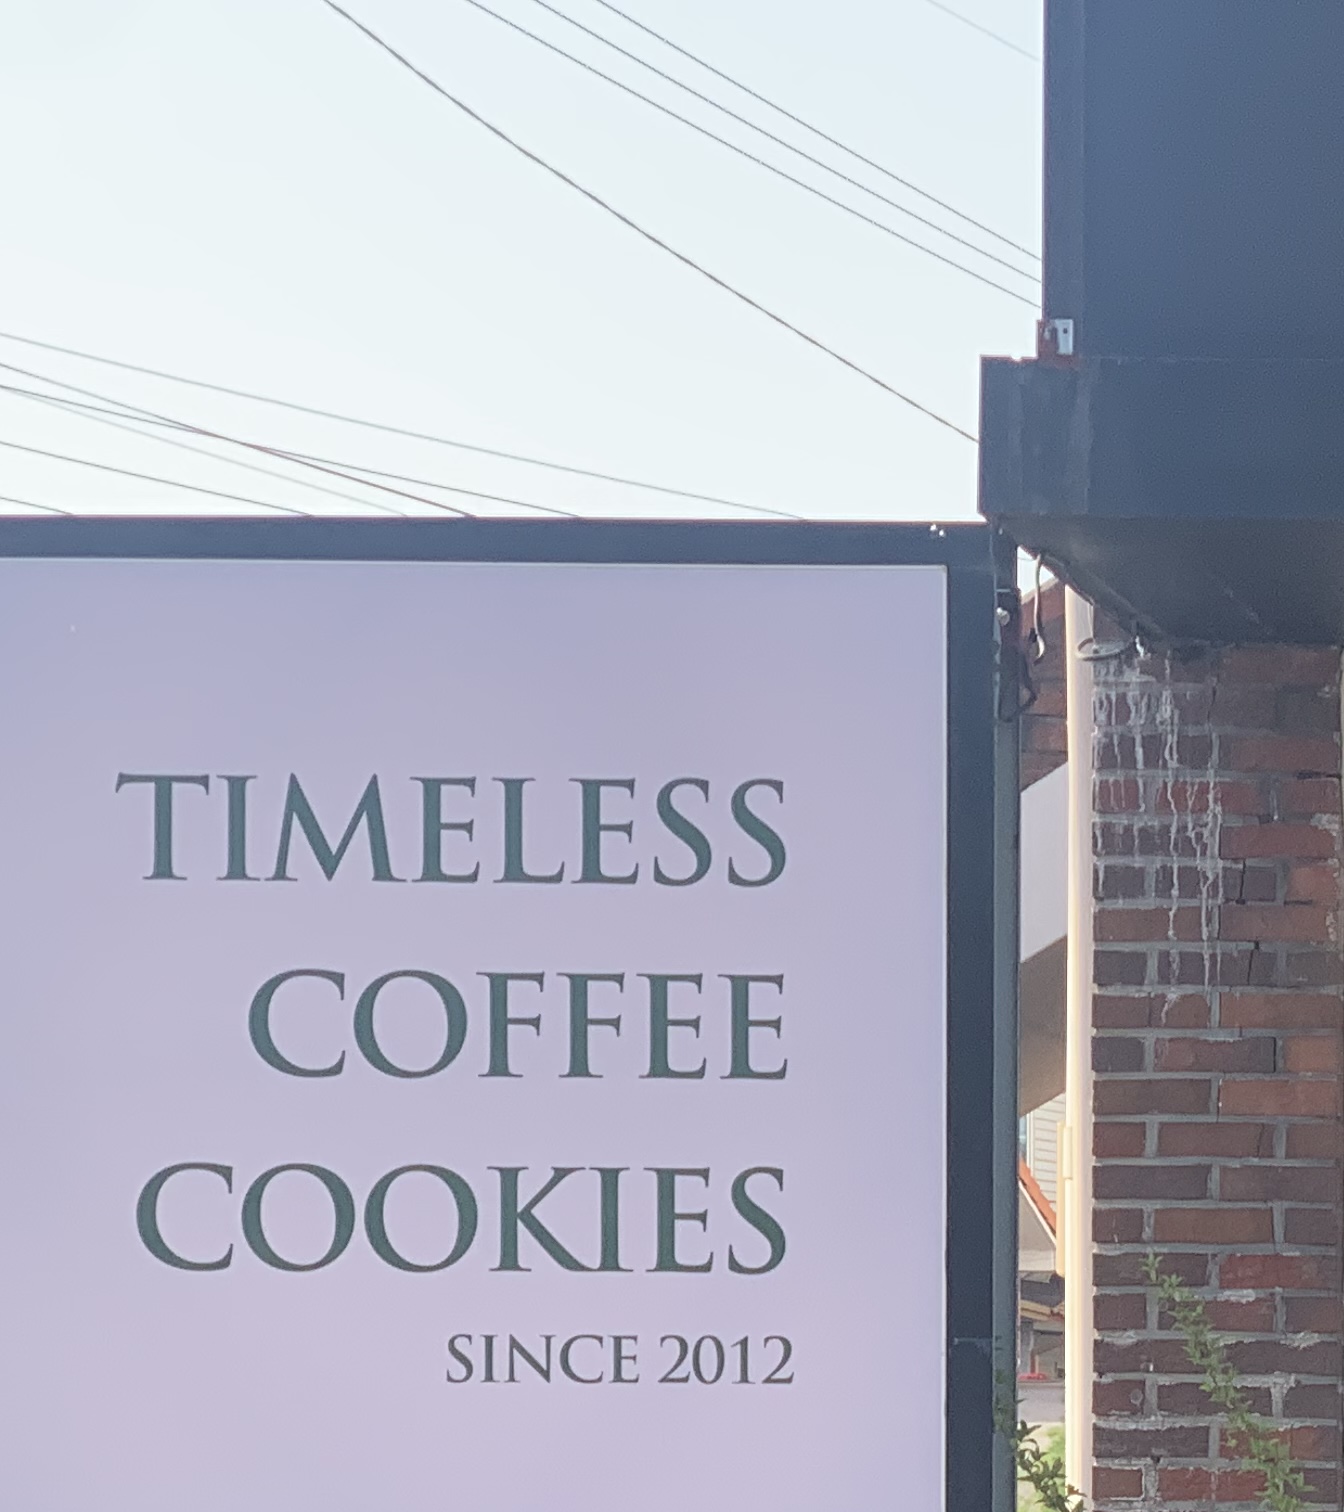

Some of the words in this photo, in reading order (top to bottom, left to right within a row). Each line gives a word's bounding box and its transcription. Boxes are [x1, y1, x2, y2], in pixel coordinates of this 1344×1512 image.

[115, 771, 787, 888] TIMELESS
[248, 968, 788, 1081] COFFEE
[135, 1162, 787, 1276] COOKIES
[446, 1333, 640, 1385] SINCE
[657, 1334, 795, 1385] 2012
